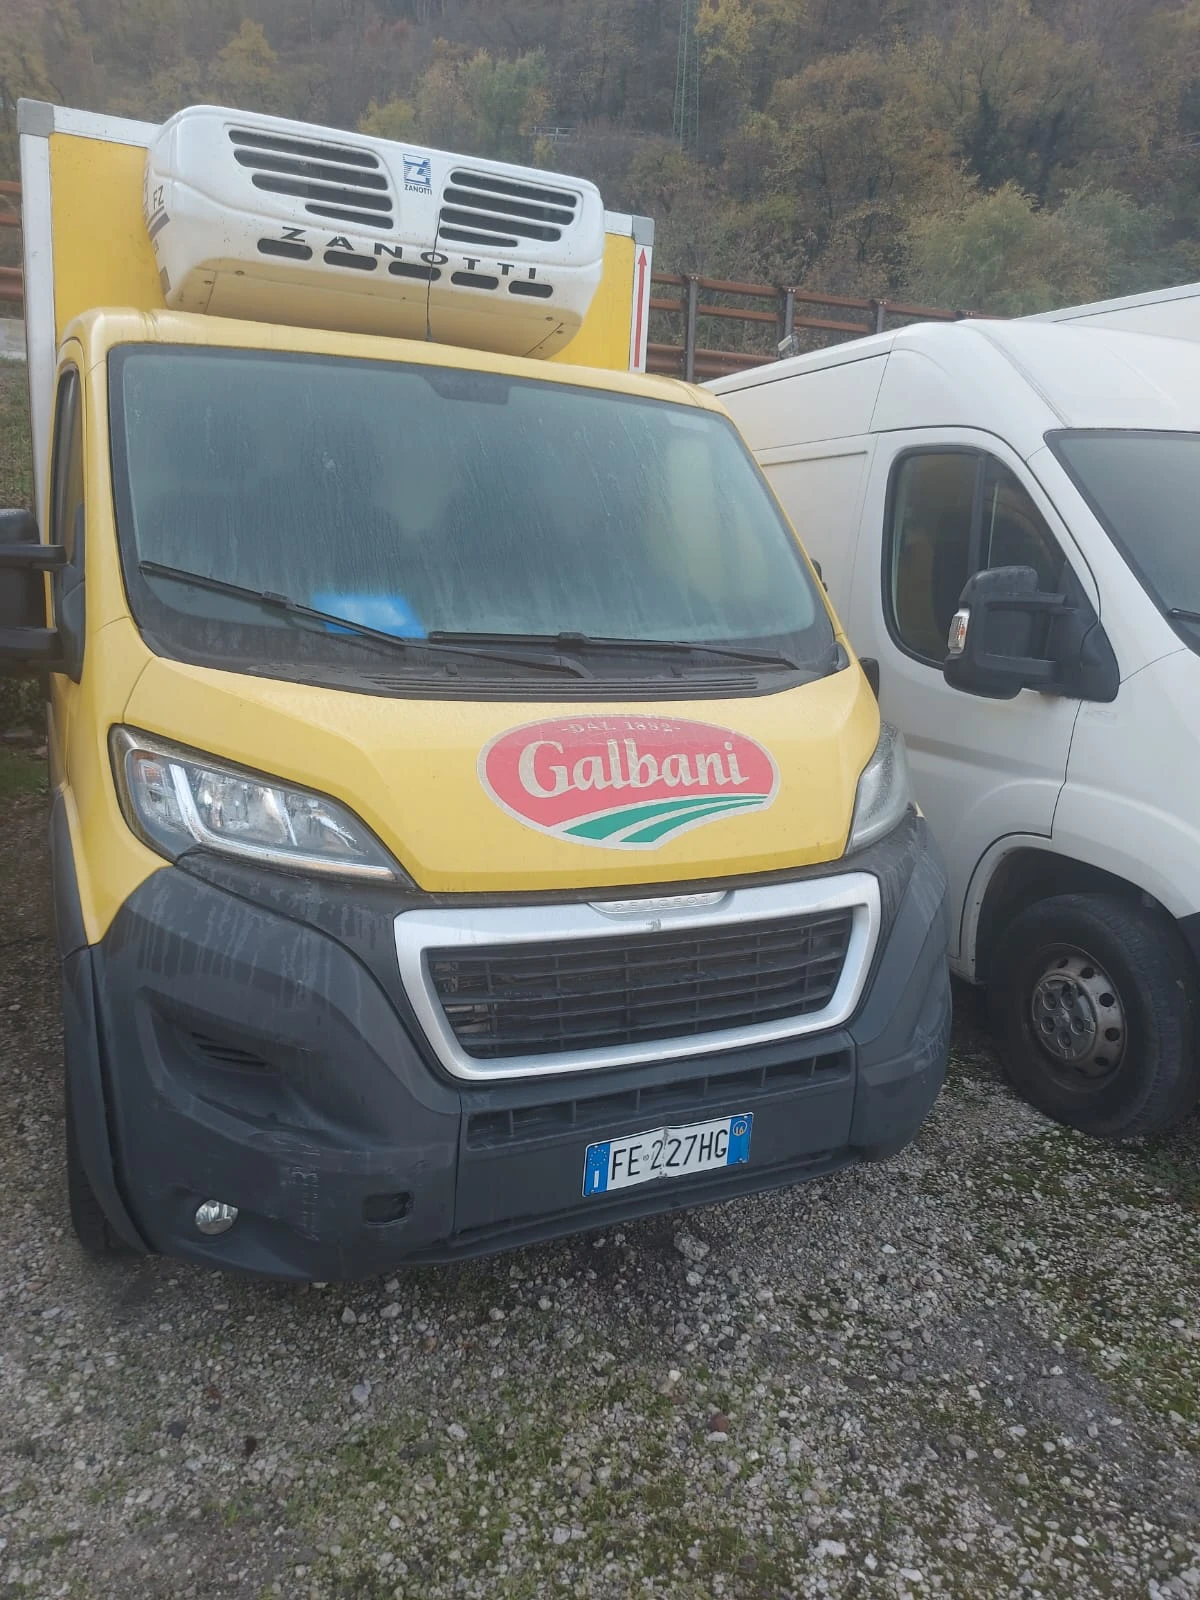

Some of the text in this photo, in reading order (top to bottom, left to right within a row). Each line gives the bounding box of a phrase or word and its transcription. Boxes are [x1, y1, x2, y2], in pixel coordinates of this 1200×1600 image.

[404, 184, 432, 196] ZANOTTI
[281, 226, 537, 280] ZANOTTI
[517, 738, 750, 799] Galbani
